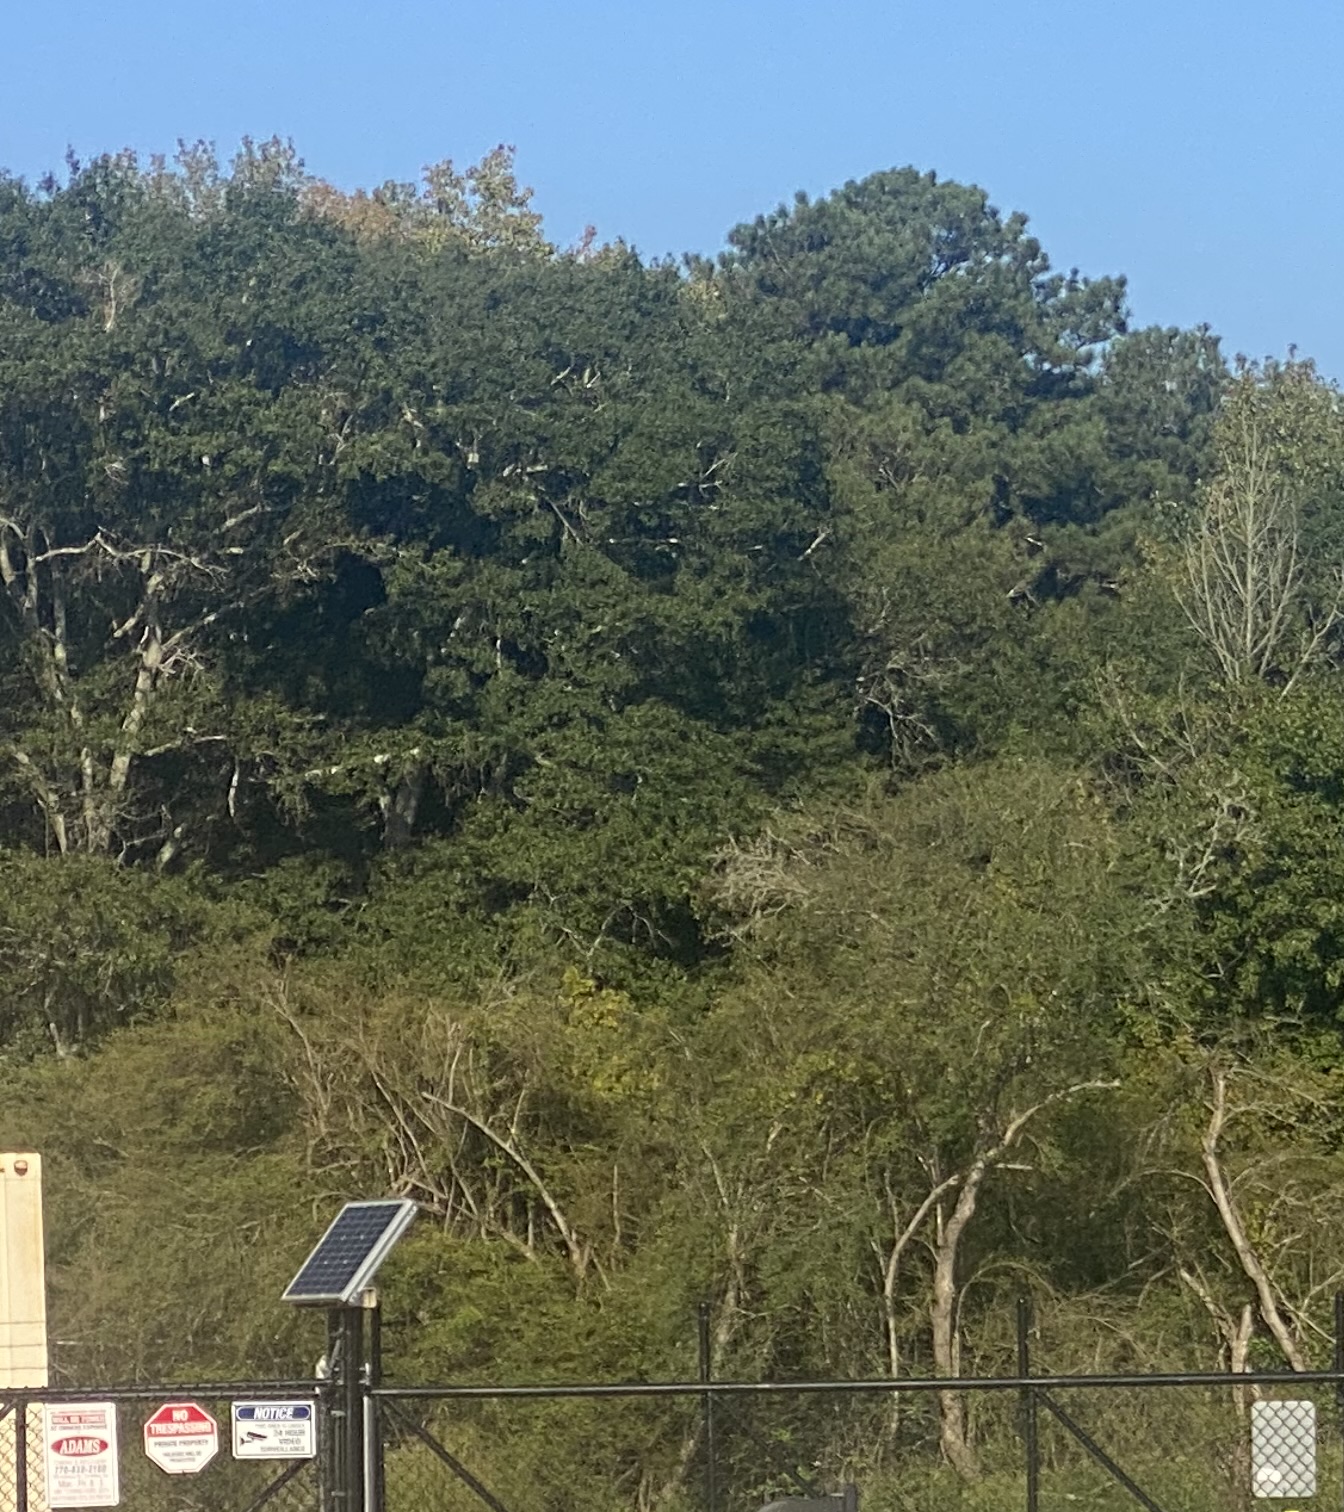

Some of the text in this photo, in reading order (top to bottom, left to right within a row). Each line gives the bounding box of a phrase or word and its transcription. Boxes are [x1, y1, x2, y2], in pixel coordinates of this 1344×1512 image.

[172, 1409, 189, 1422] NO
[253, 1407, 294, 1420] NOTICE
[150, 1421, 212, 1435] TRESPASSING
[59, 1439, 101, 1455] ADAMS
